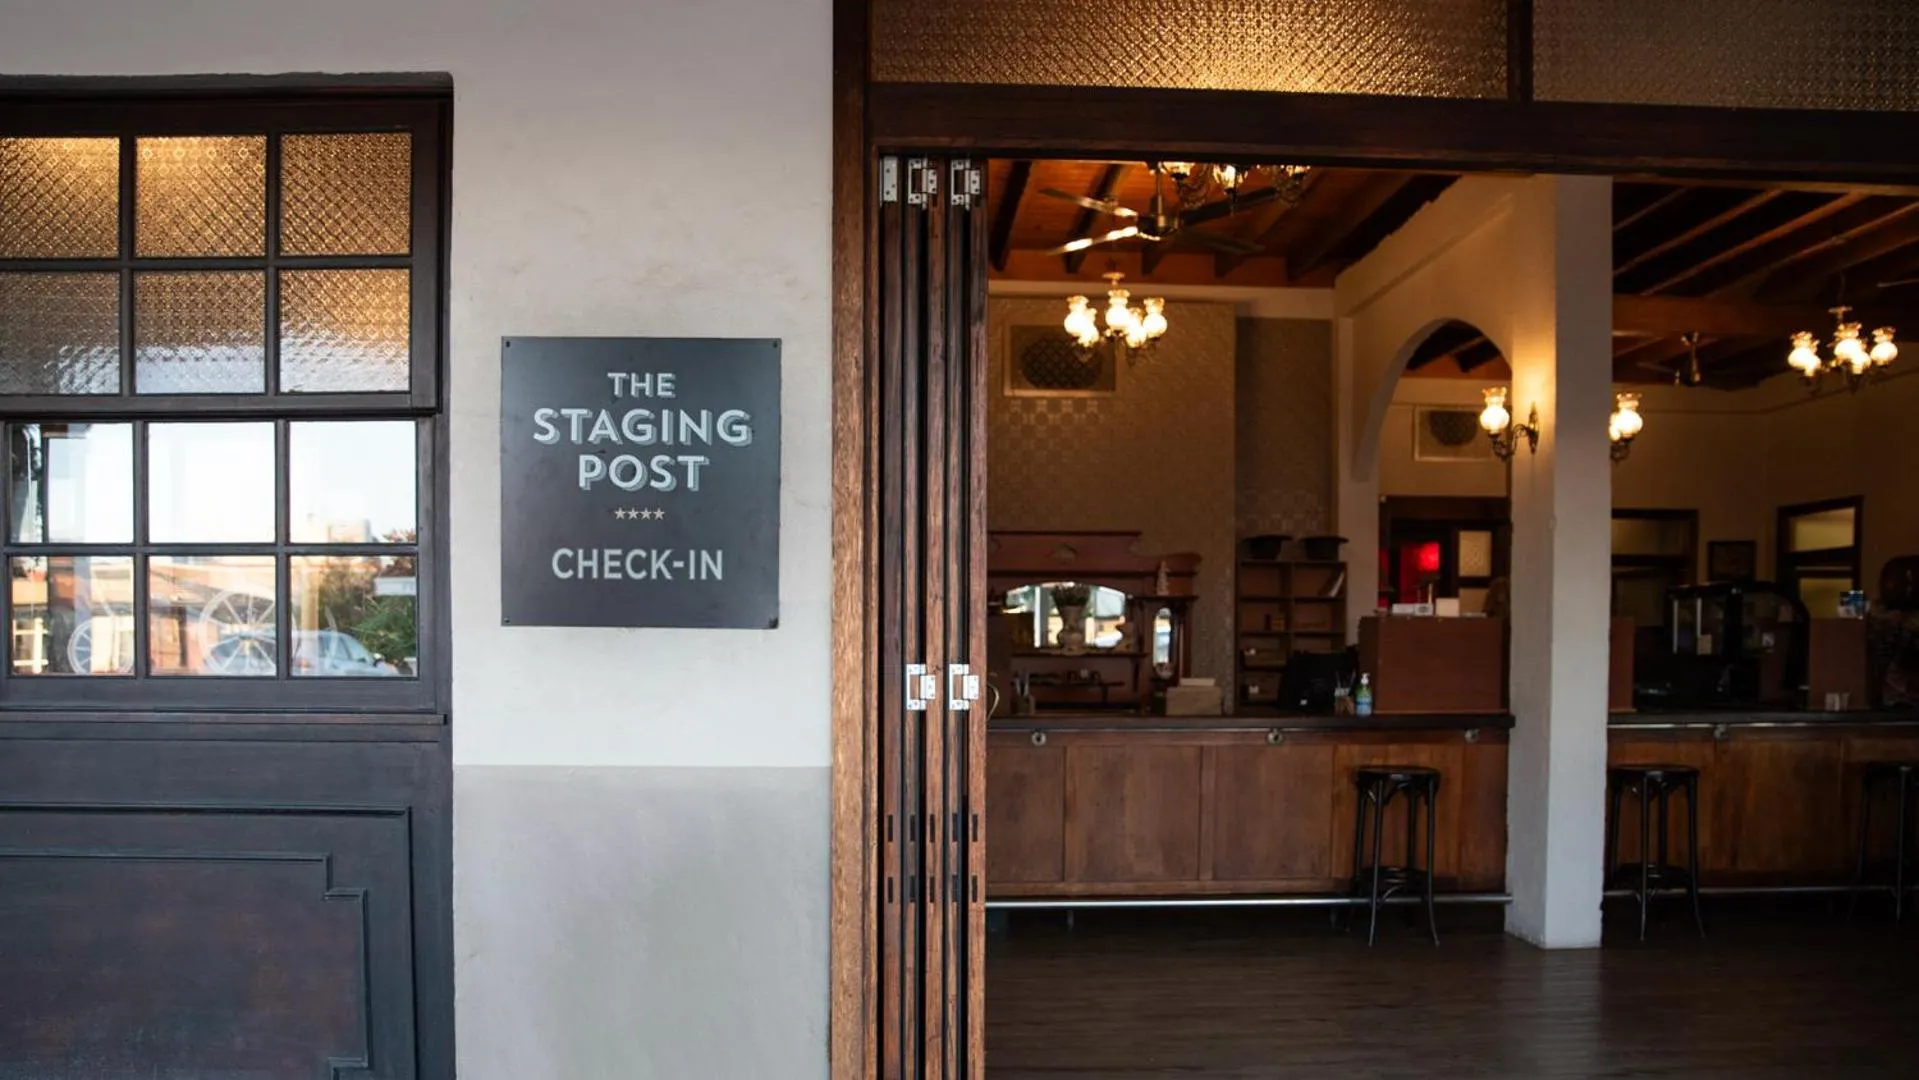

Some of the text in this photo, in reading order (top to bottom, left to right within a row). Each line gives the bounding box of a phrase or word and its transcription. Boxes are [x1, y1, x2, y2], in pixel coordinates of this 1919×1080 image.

[607, 372, 677, 398] THE
[533, 407, 753, 447] STAGING
[578, 454, 710, 492] POST
[551, 547, 723, 580] CHECK-IN
